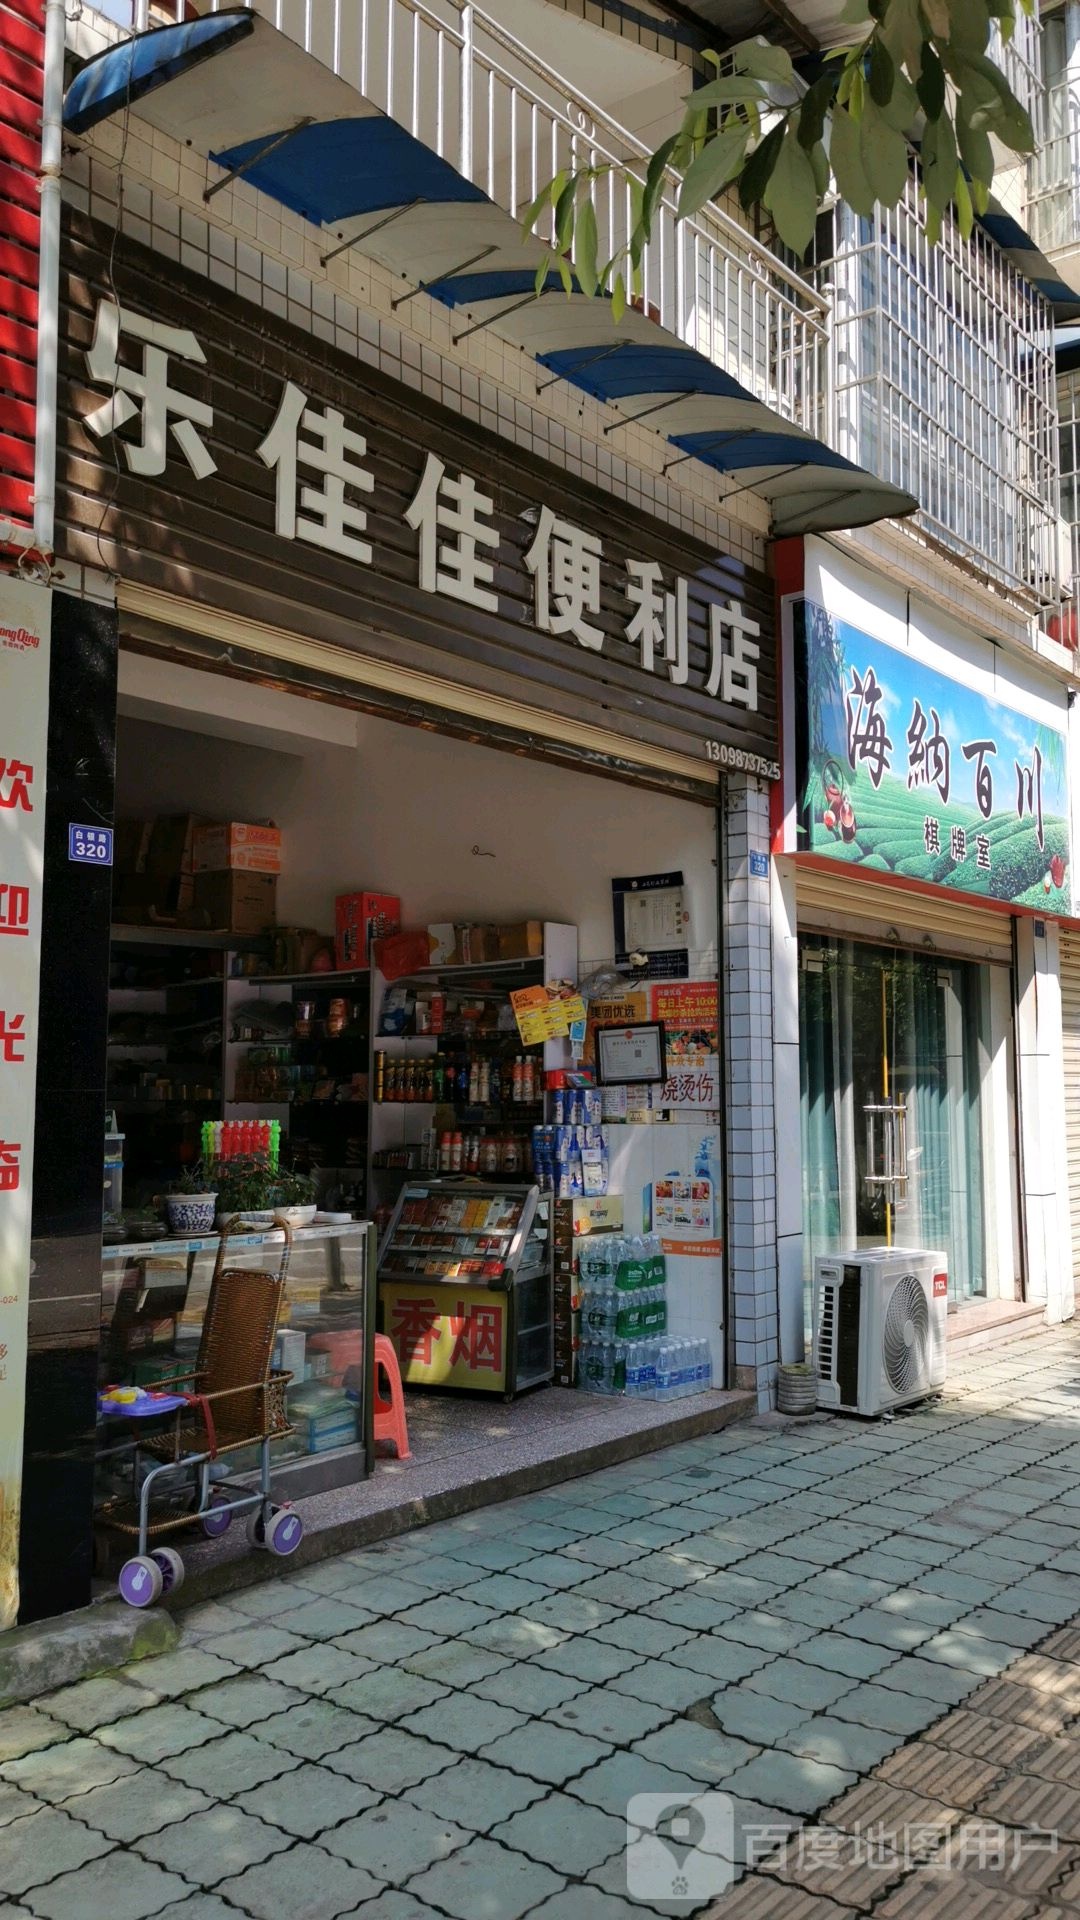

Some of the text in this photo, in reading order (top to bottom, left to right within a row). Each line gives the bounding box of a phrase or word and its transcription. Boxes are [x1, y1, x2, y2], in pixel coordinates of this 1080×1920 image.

[83, 298, 760, 712] 乐佳佳便利店
[705, 740, 781, 780] 13098737525
[76, 842, 107, 858] 320
[924, 817, 991, 870] 棋牌室
[591, 1004, 636, 1018] 美团优选
[660, 1072, 714, 1103] 烧烫伤
[935, 1280, 946, 1291] TCL
[391, 1298, 503, 1373] 香烟
